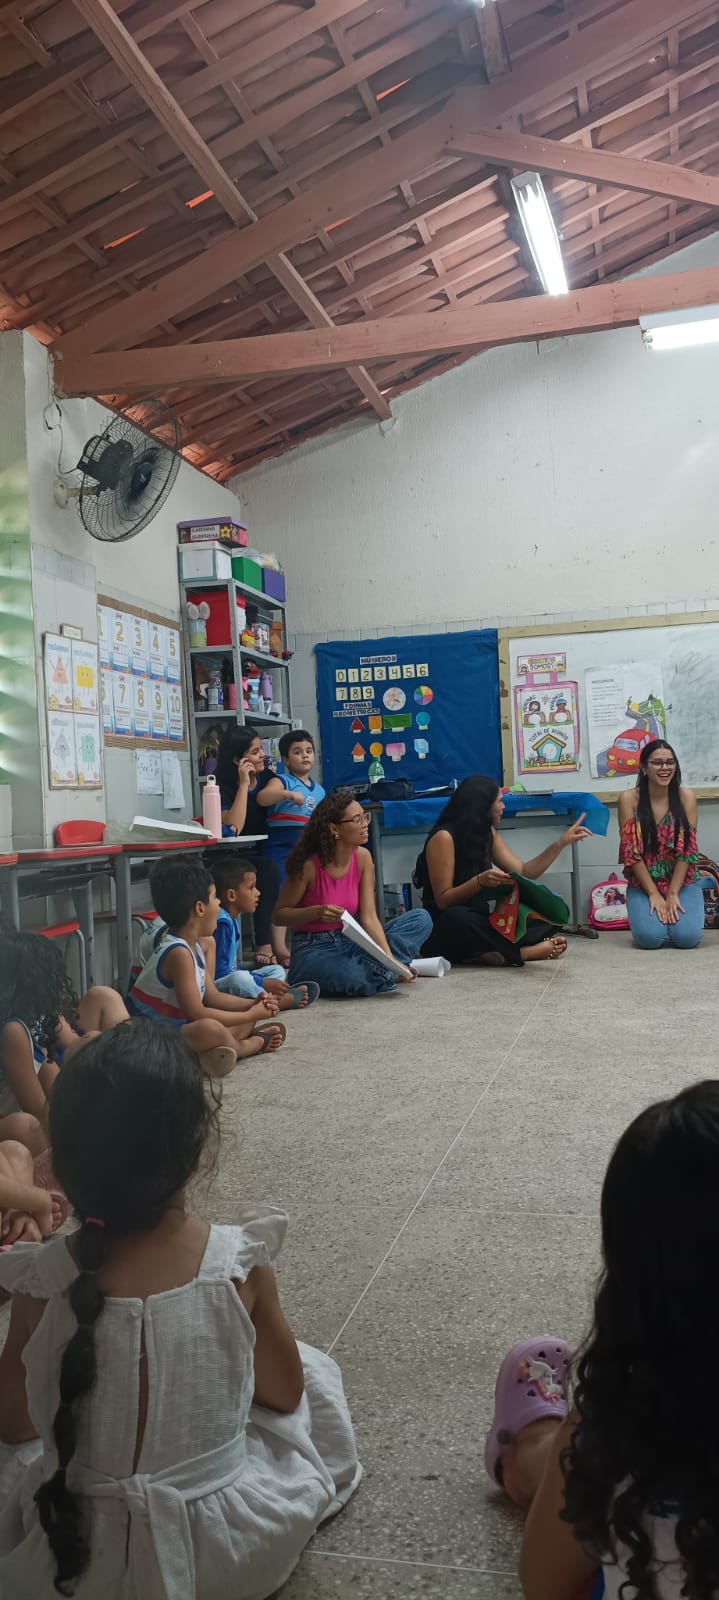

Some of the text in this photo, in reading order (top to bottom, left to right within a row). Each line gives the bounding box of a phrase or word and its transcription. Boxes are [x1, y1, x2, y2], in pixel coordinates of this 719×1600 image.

[115, 621, 125, 642] 2
[134, 626, 143, 647] 3
[152, 632, 160, 652] 4
[169, 638, 176, 657] 5
[337, 671, 344, 681] 0
[363, 670, 371, 681] 2
[377, 669, 384, 679] 3
[391, 668, 398, 678] 4
[405, 667, 412, 677] 5
[420, 666, 426, 676] 6
[119, 683, 126, 704] 7
[138, 687, 145, 708] 8
[155, 691, 162, 711] 9
[170, 694, 181, 714] 10
[339, 688, 372, 699] 7 8 9
